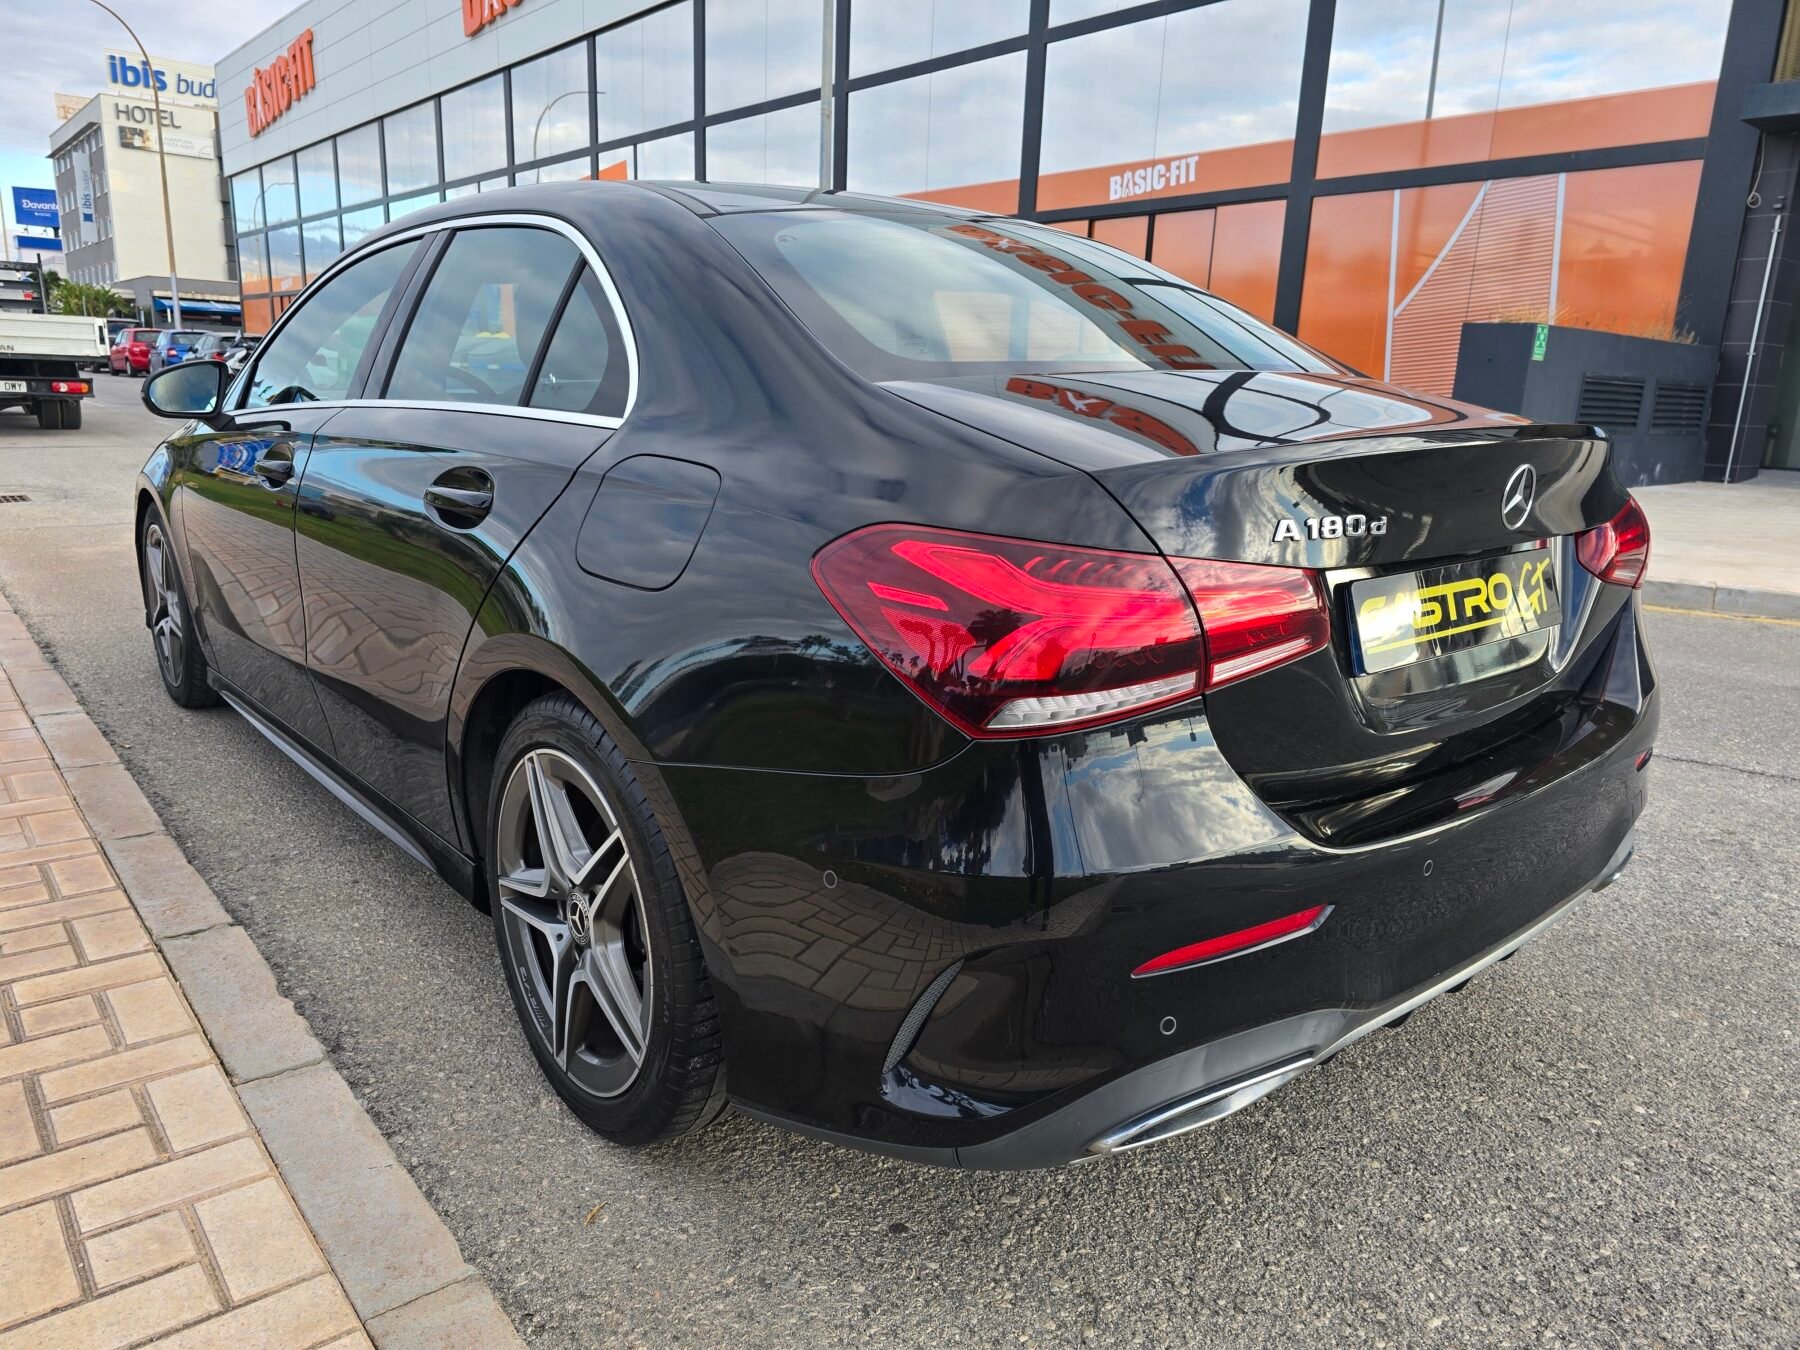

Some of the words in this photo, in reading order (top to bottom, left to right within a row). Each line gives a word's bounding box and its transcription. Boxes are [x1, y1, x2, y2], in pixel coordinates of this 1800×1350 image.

[109, 55, 168, 92] ibis
[177, 73, 217, 99] bud
[115, 102, 182, 129] HOTEL
[81, 193, 93, 210] ibis
[1272, 519, 1301, 543] A
[1512, 557, 1551, 620] GT
